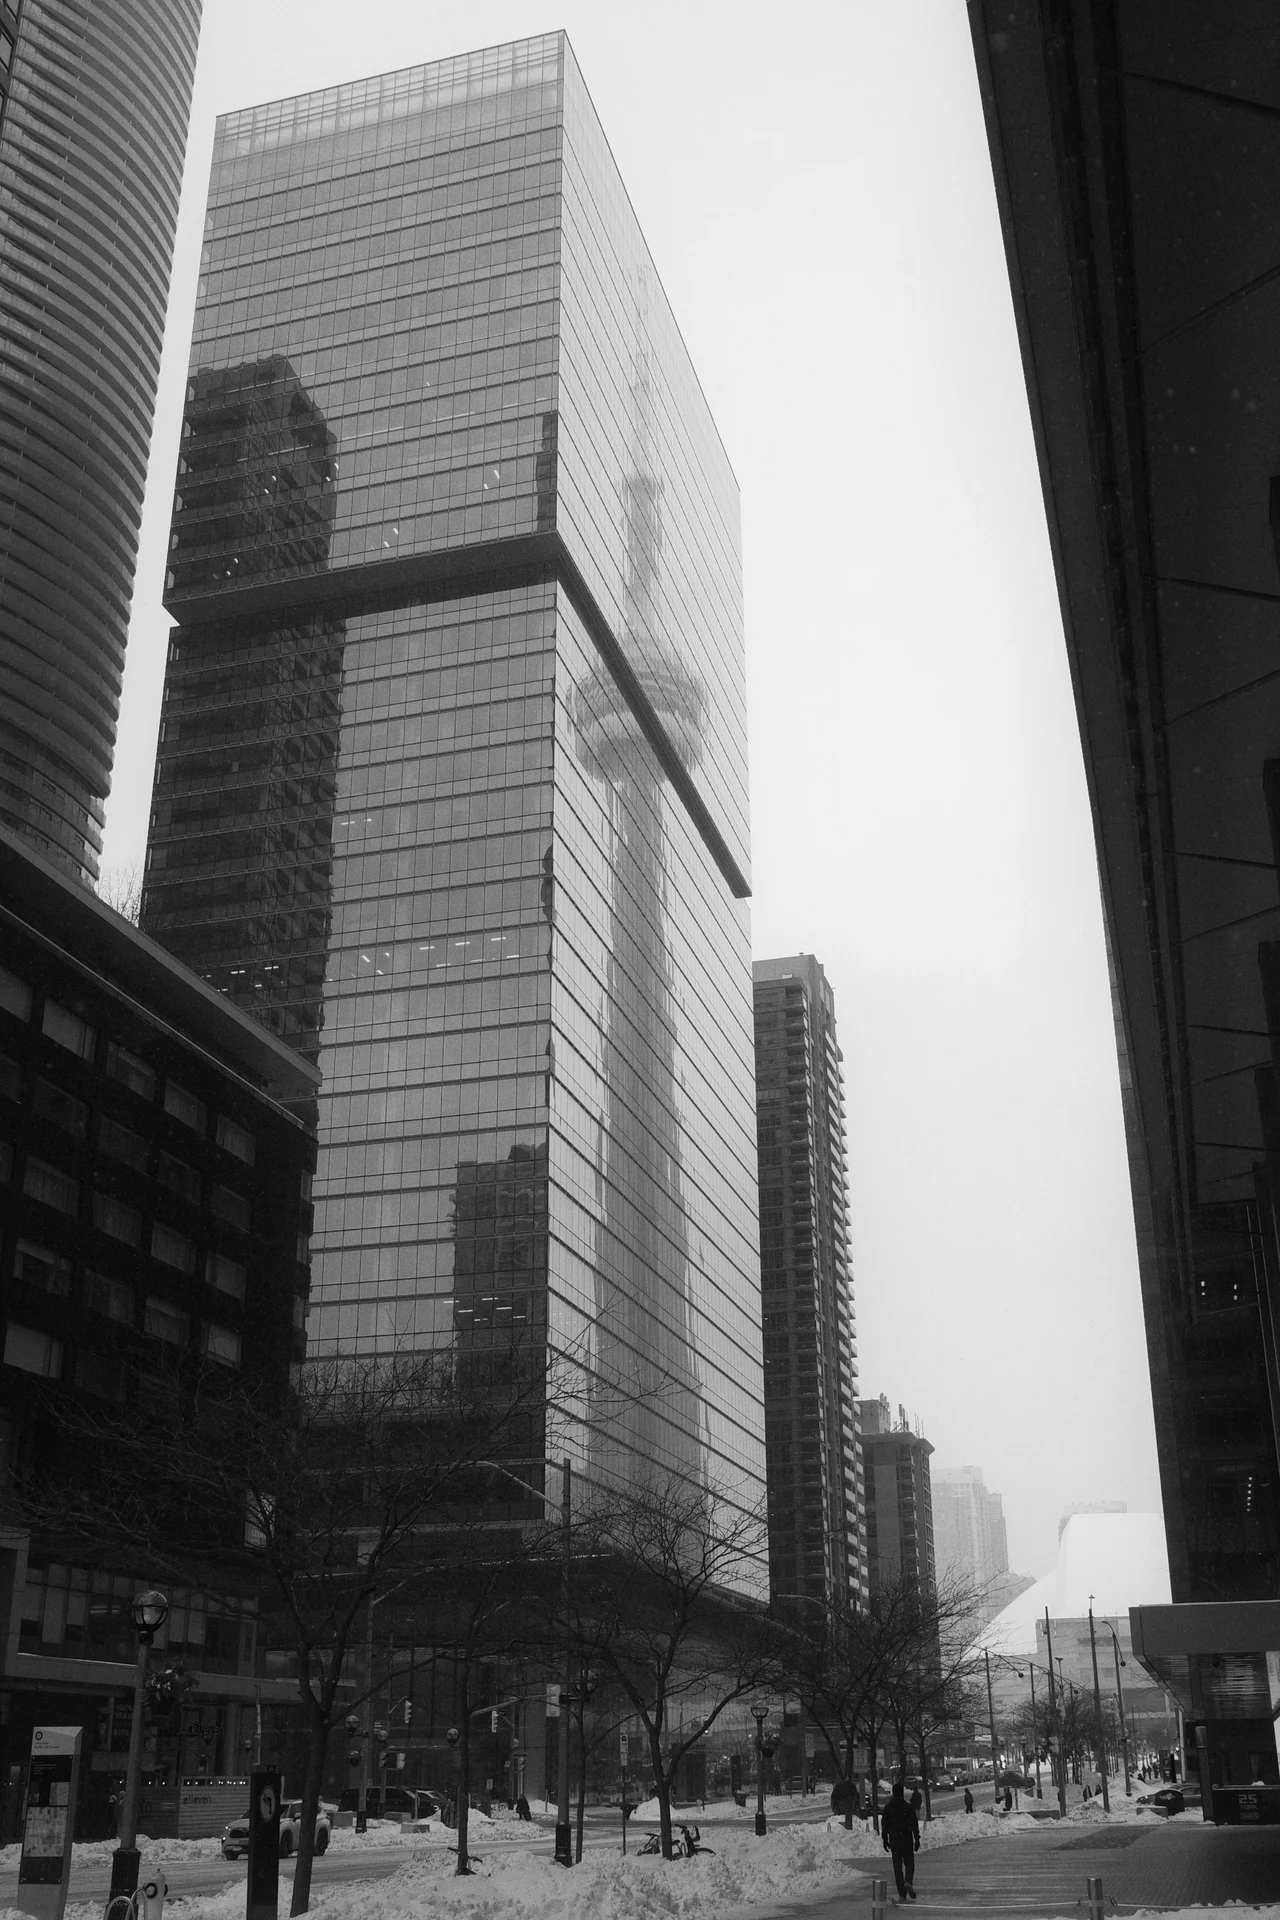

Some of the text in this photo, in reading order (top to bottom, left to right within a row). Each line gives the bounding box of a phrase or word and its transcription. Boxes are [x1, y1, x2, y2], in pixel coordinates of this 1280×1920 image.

[191, 1724, 224, 1735] elleven
[183, 1795, 212, 1804] elleven
[1238, 1794, 1257, 1804] 25
